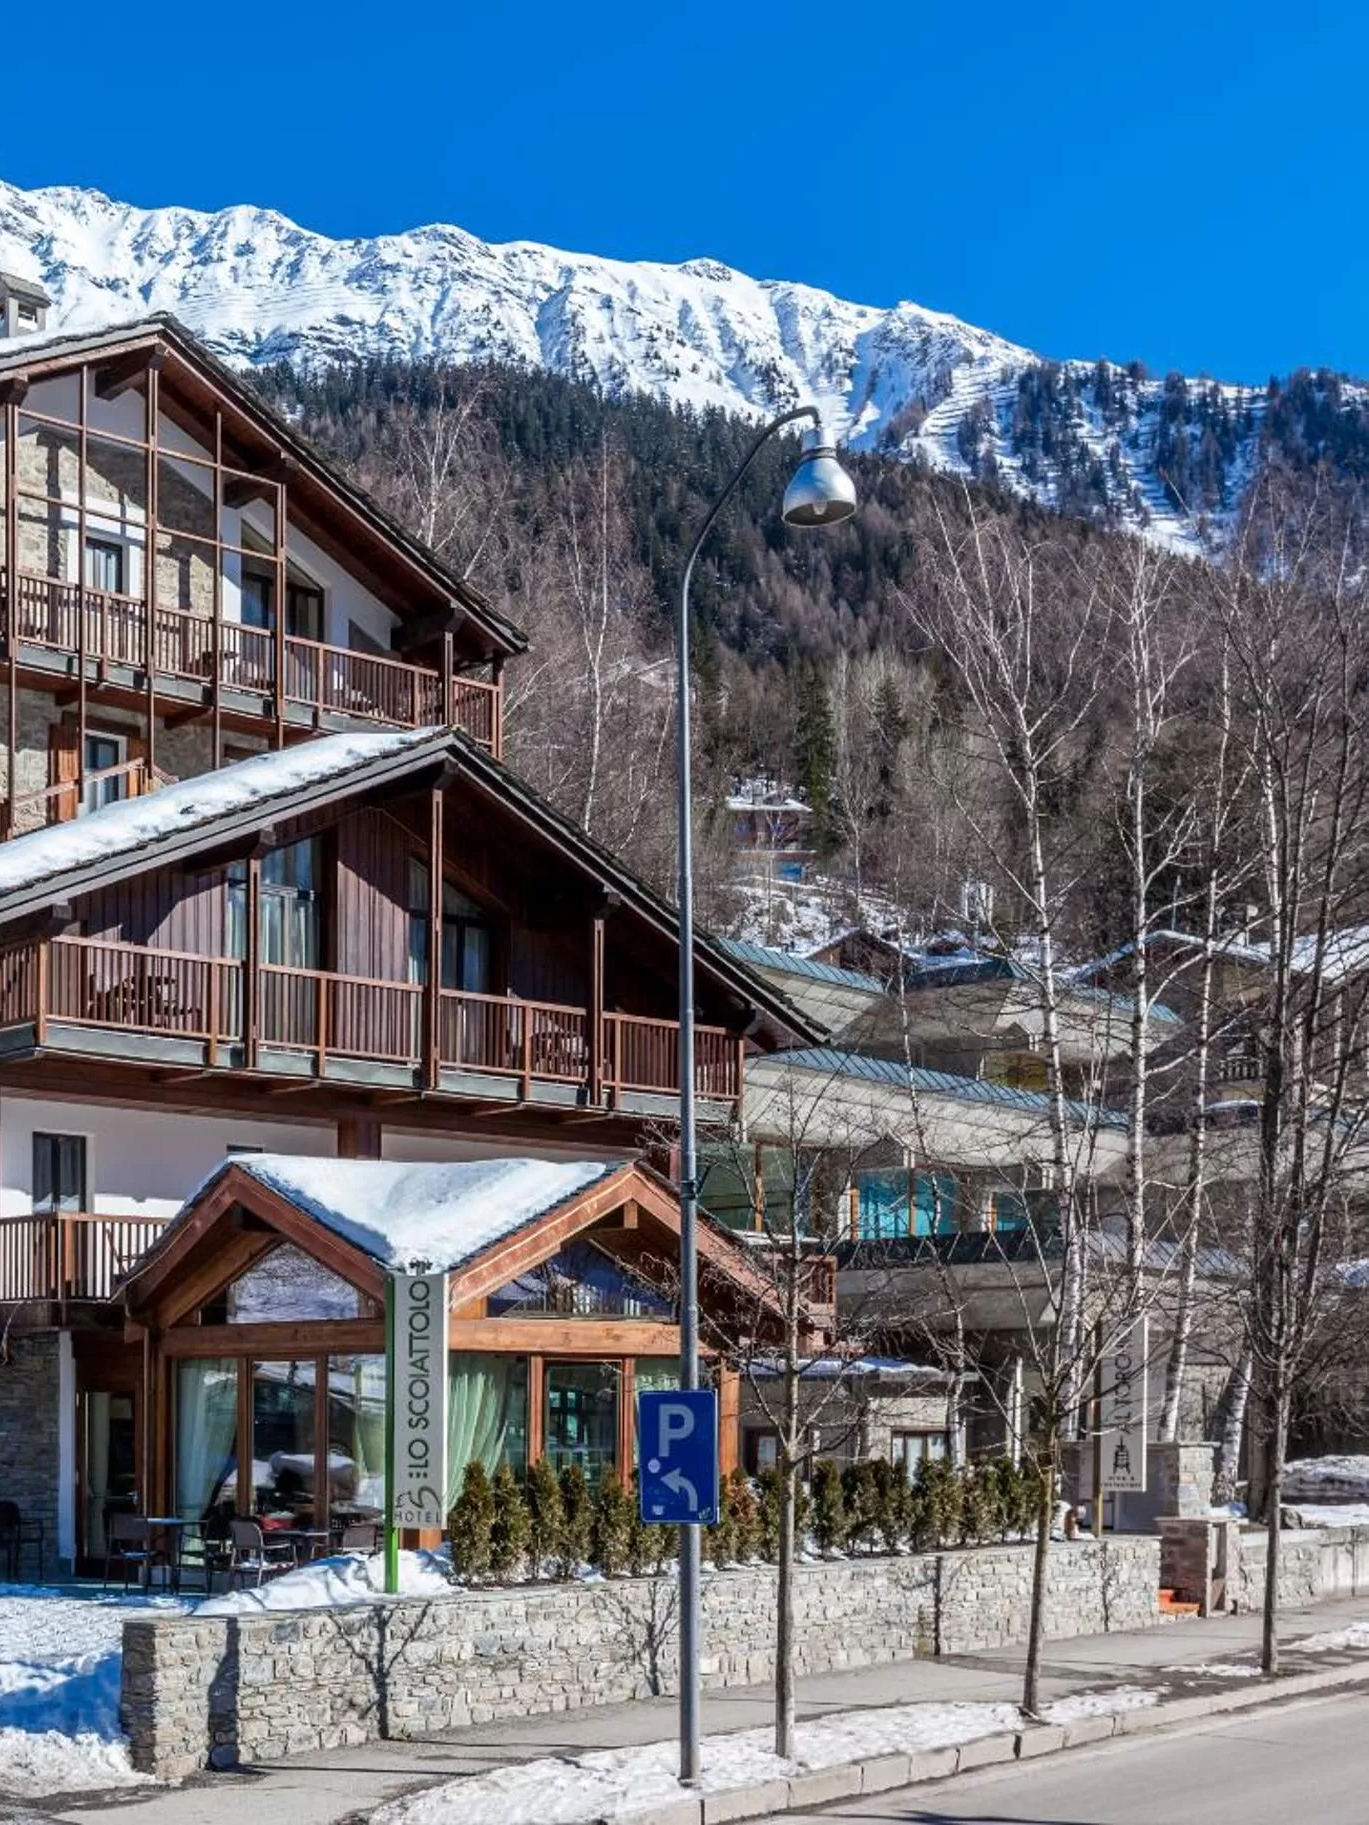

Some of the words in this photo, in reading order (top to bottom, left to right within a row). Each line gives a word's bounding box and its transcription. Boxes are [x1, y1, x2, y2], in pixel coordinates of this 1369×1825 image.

[408, 1279, 430, 1430] SCOIATTOLO
[658, 1403, 695, 1457] P
[408, 1438, 429, 1469] LO
[394, 1511, 443, 1524] HOTEL
